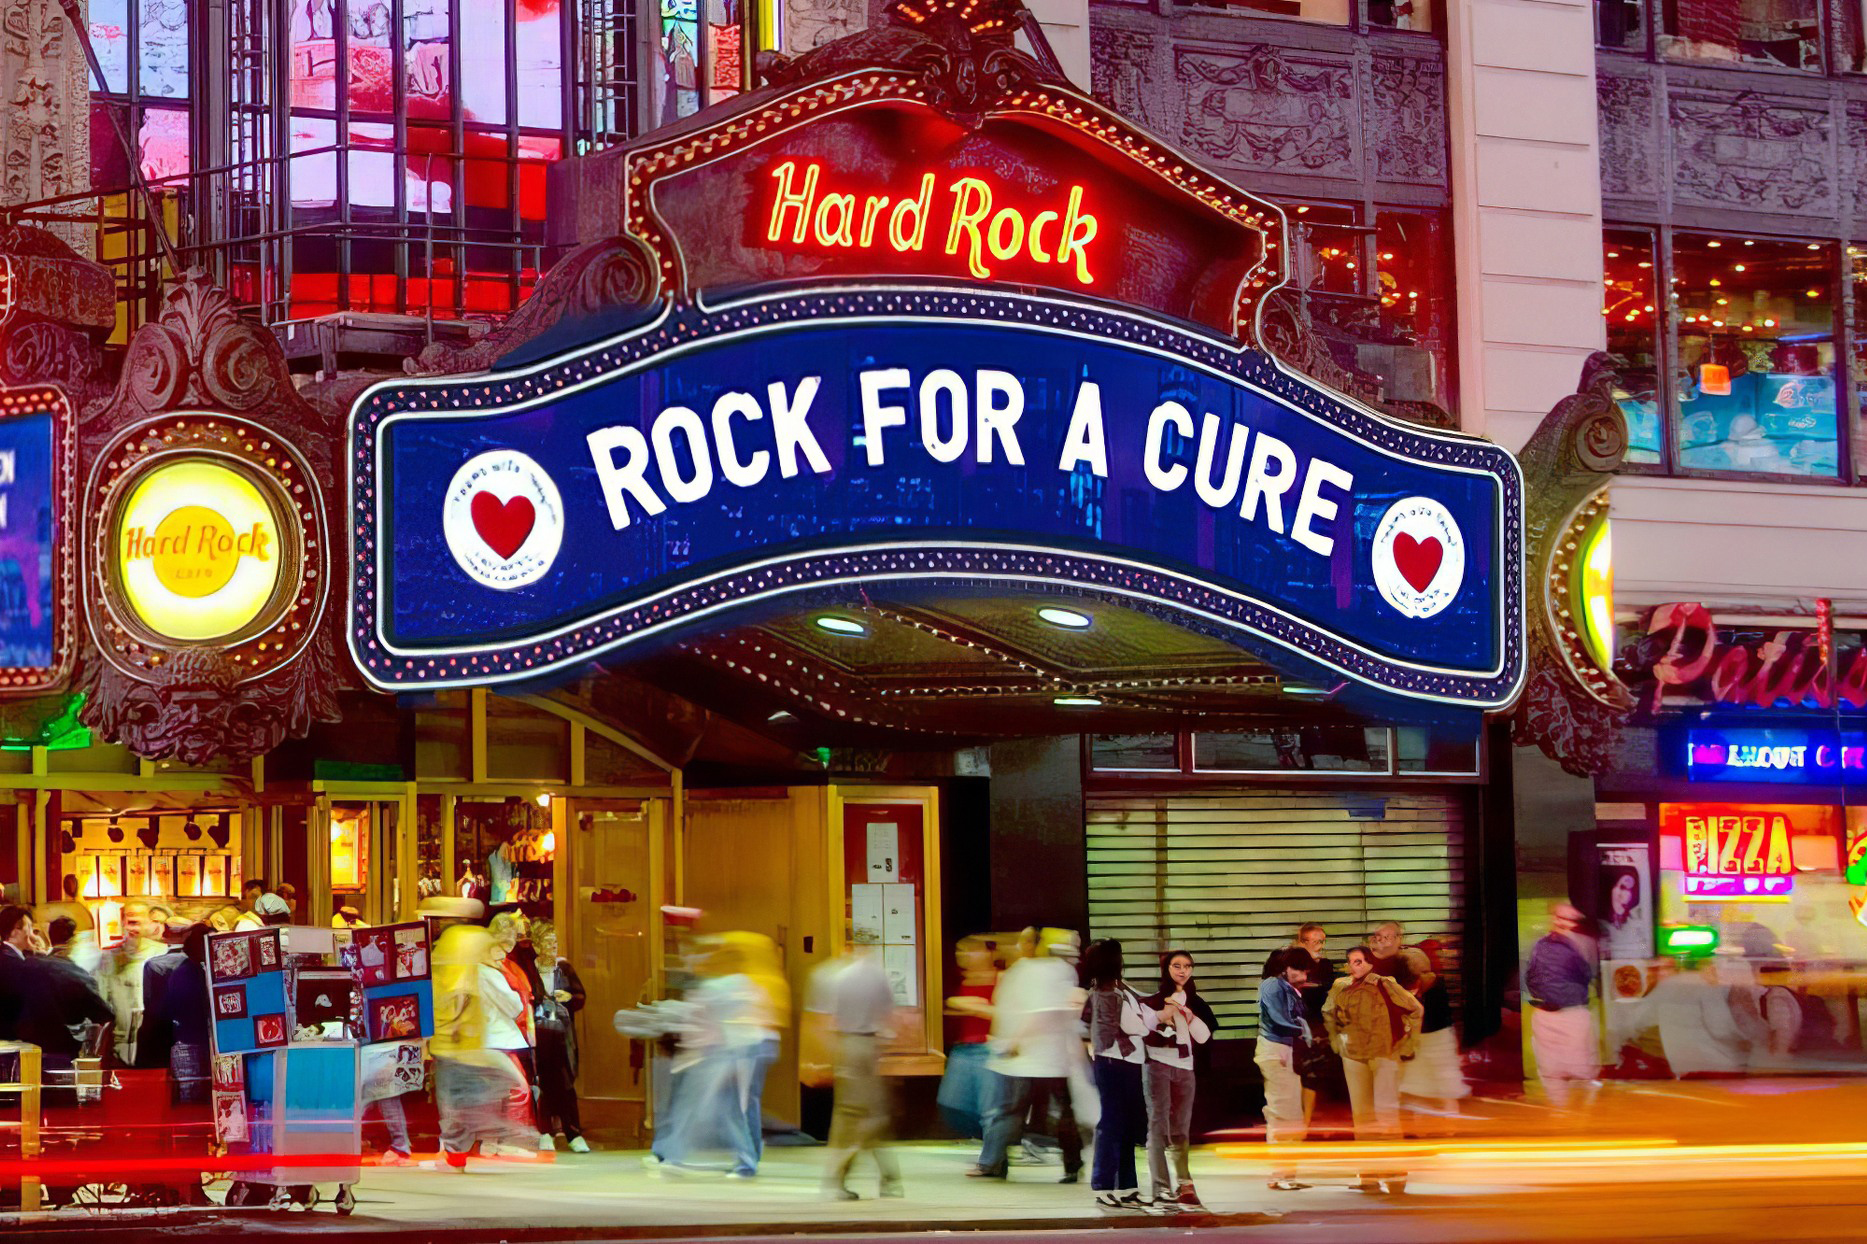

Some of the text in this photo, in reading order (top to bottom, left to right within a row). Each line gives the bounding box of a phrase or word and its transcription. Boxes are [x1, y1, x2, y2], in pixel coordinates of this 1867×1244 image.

[767, 161, 1099, 285] Hard Rock
[586, 375, 833, 531] ROCK
[859, 367, 1026, 467] FOR
[1058, 380, 1109, 479] A
[1143, 400, 1355, 557] CURE
[125, 522, 270, 562] Hard Rock
[1685, 815, 1792, 875] PIZZA
